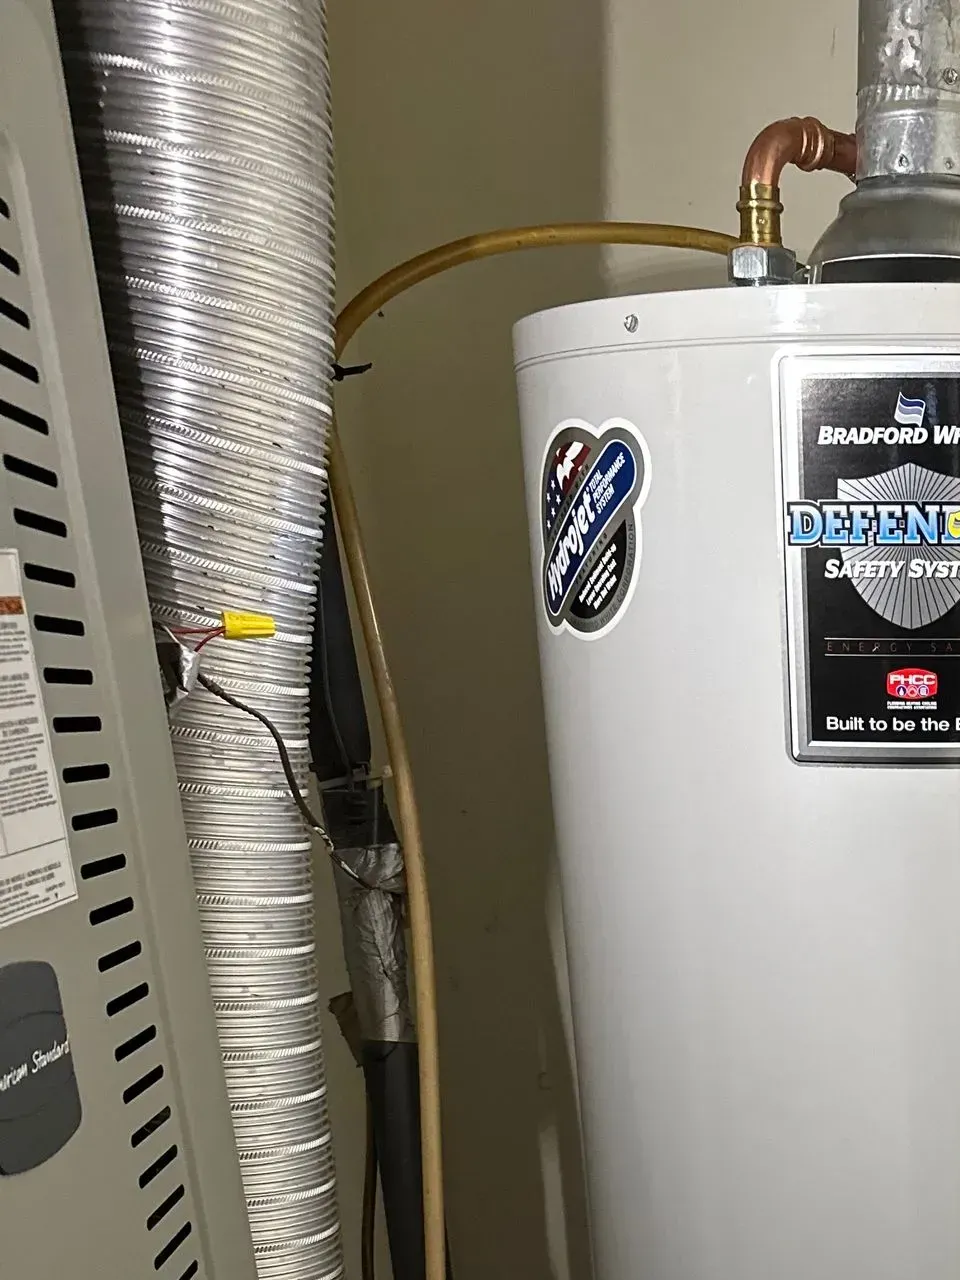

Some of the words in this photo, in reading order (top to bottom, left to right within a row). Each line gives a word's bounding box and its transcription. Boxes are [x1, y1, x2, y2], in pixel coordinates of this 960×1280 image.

[818, 425, 929, 445] BRADFORD
[588, 468, 604, 493] TOTAL
[592, 451, 626, 504] PERFORMANCE
[595, 483, 615, 515] SYSTEM
[547, 490, 596, 602] Hydrojet
[824, 558, 905, 579] SAFETY
[827, 642, 913, 653] ENERGY
[889, 674, 937, 686] PHCC
[826, 716, 866, 732] Built
[868, 718, 888, 732] to
[892, 716, 916, 732] be
[920, 716, 950, 732] the
[32, 1038, 70, 1073] Standard
